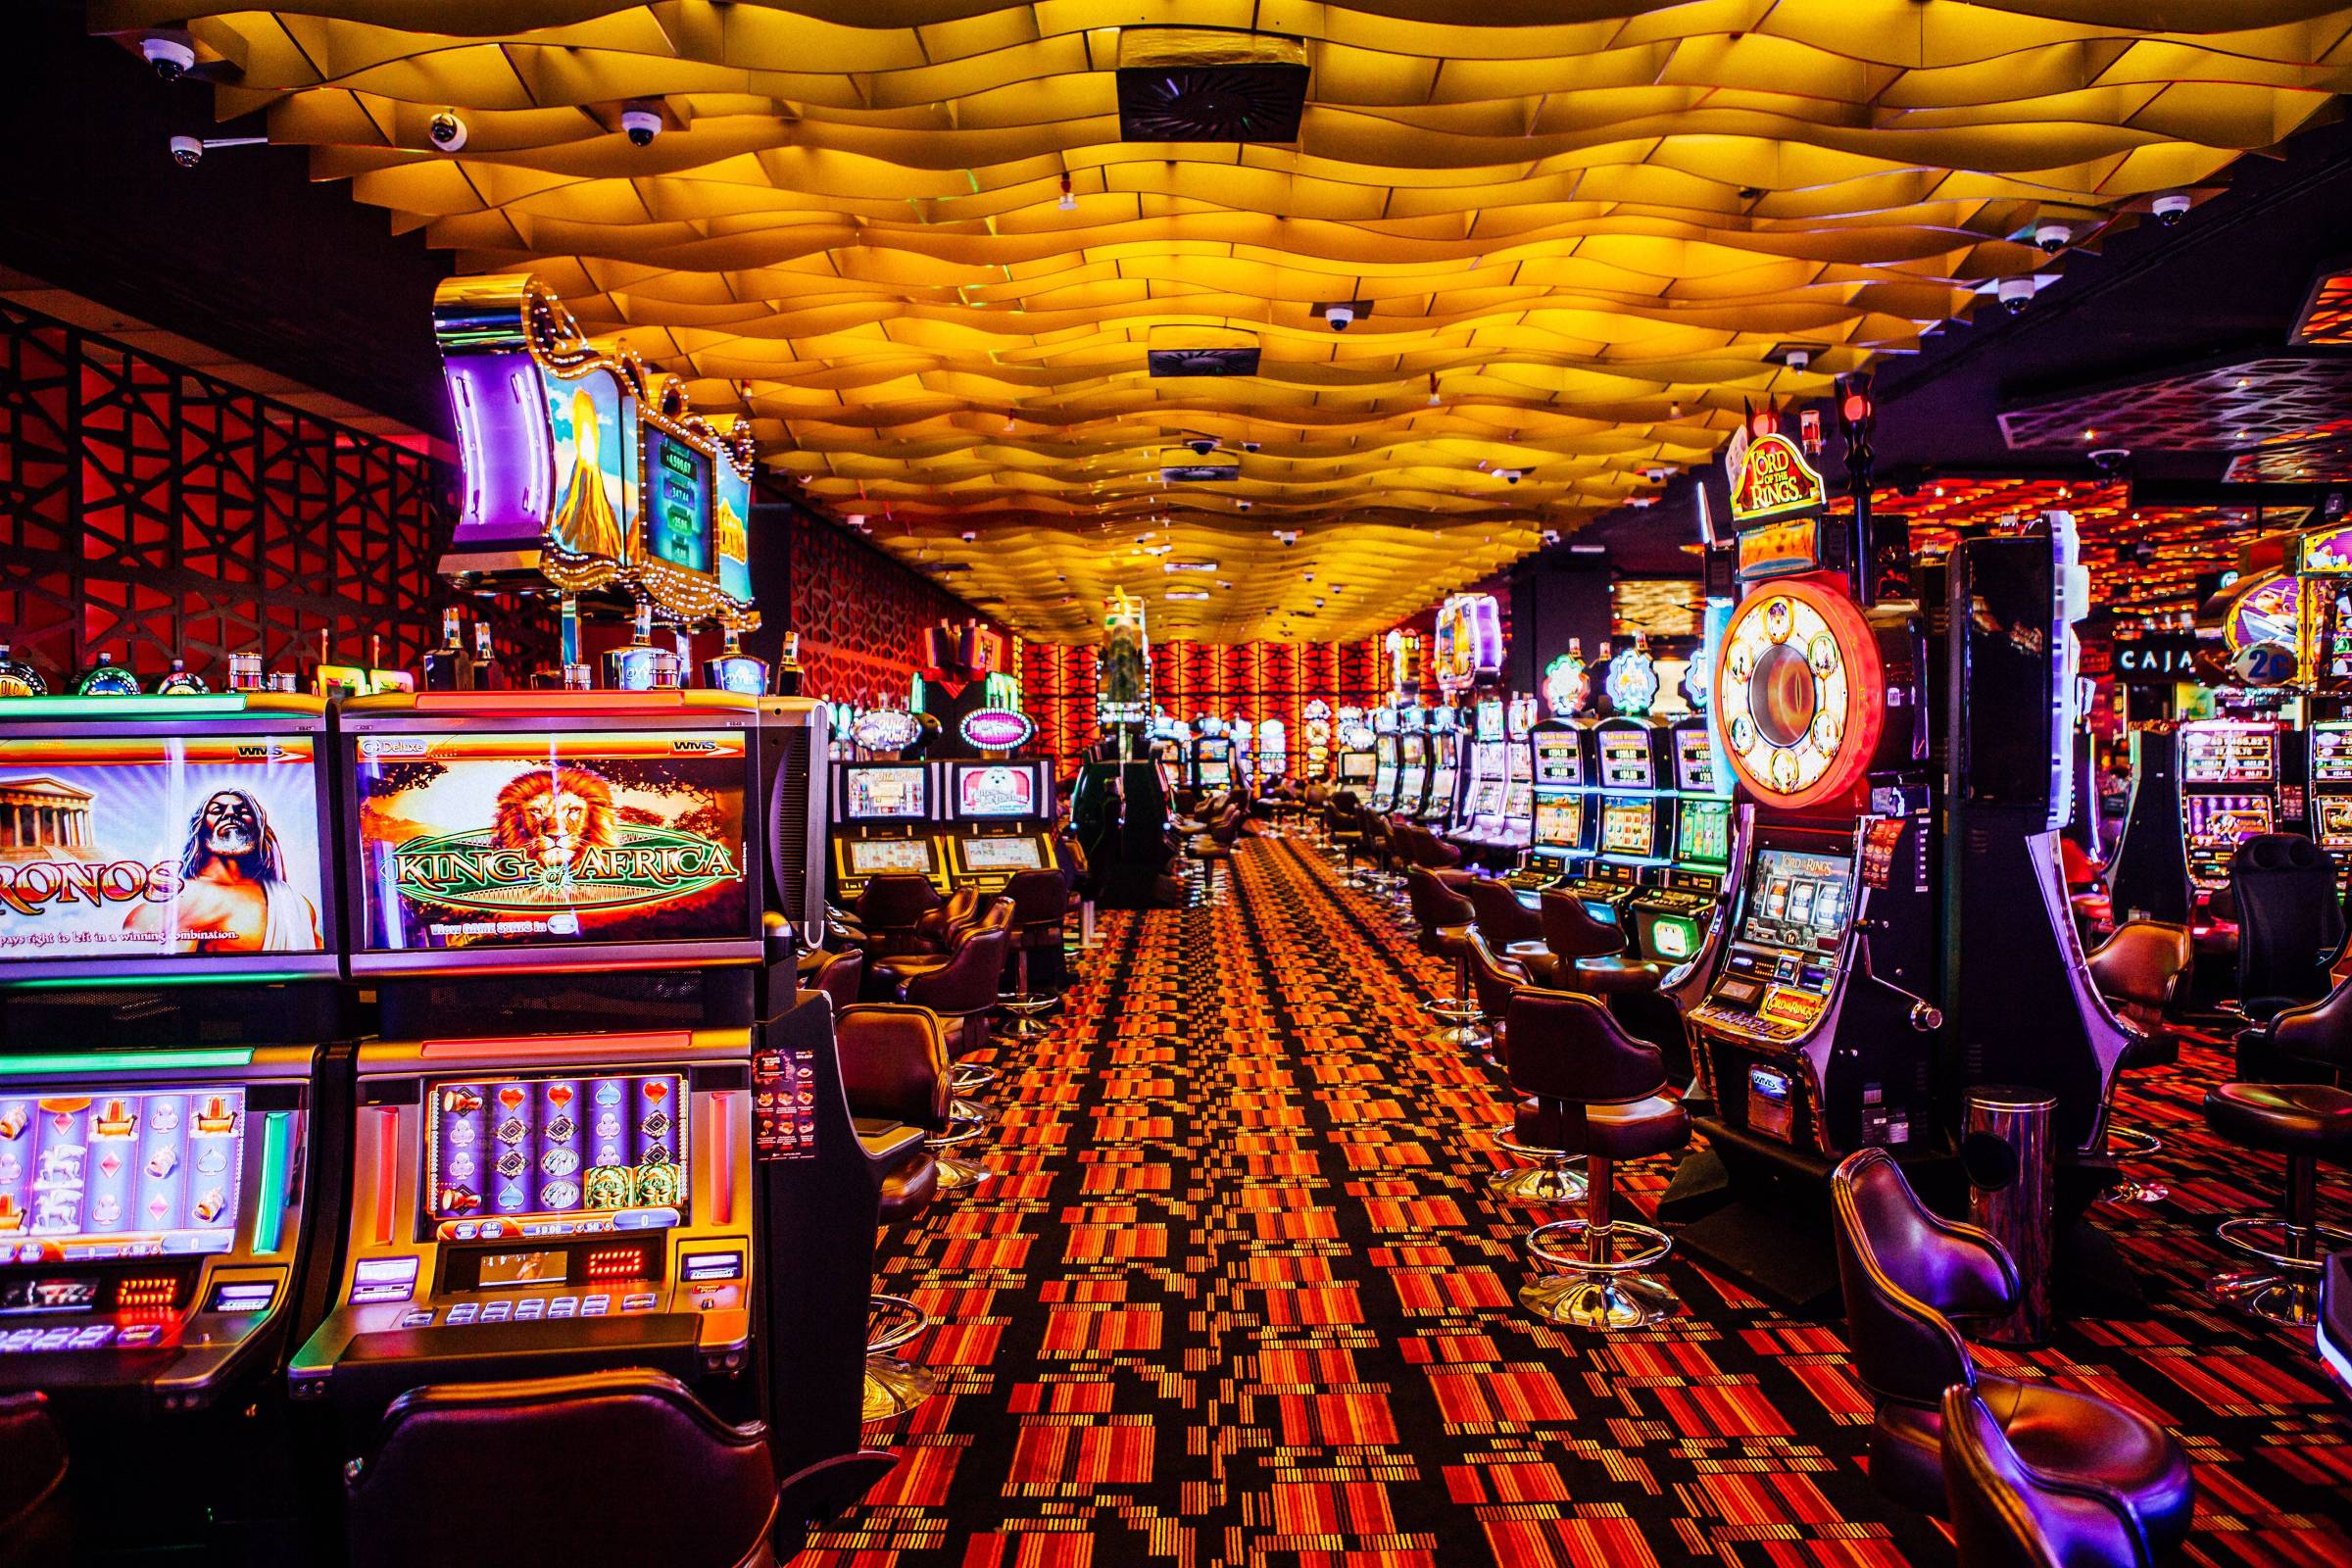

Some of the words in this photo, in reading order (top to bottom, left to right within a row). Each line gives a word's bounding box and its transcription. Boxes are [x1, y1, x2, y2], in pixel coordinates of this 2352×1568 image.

[1749, 451, 1789, 485] LORD
[2121, 650, 2192, 672] CAJA
[238, 745, 283, 756] WMS
[383, 740, 424, 753] Deluxe
[673, 741, 716, 750] WMS
[394, 850, 537, 893] KING
[573, 845, 739, 884] AFRICA
[1779, 854, 1801, 872] LORD
[1806, 858, 1834, 876] RINGS
[546, 869, 565, 885] of
[463, 923, 496, 934] GAME
[497, 921, 533, 933] STATS
[0, 935, 24, 948] pays
[27, 933, 55, 948] right
[58, 932, 71, 943] to
[73, 931, 92, 943] left
[94, 931, 107, 942] in
[121, 931, 166, 945] winning
